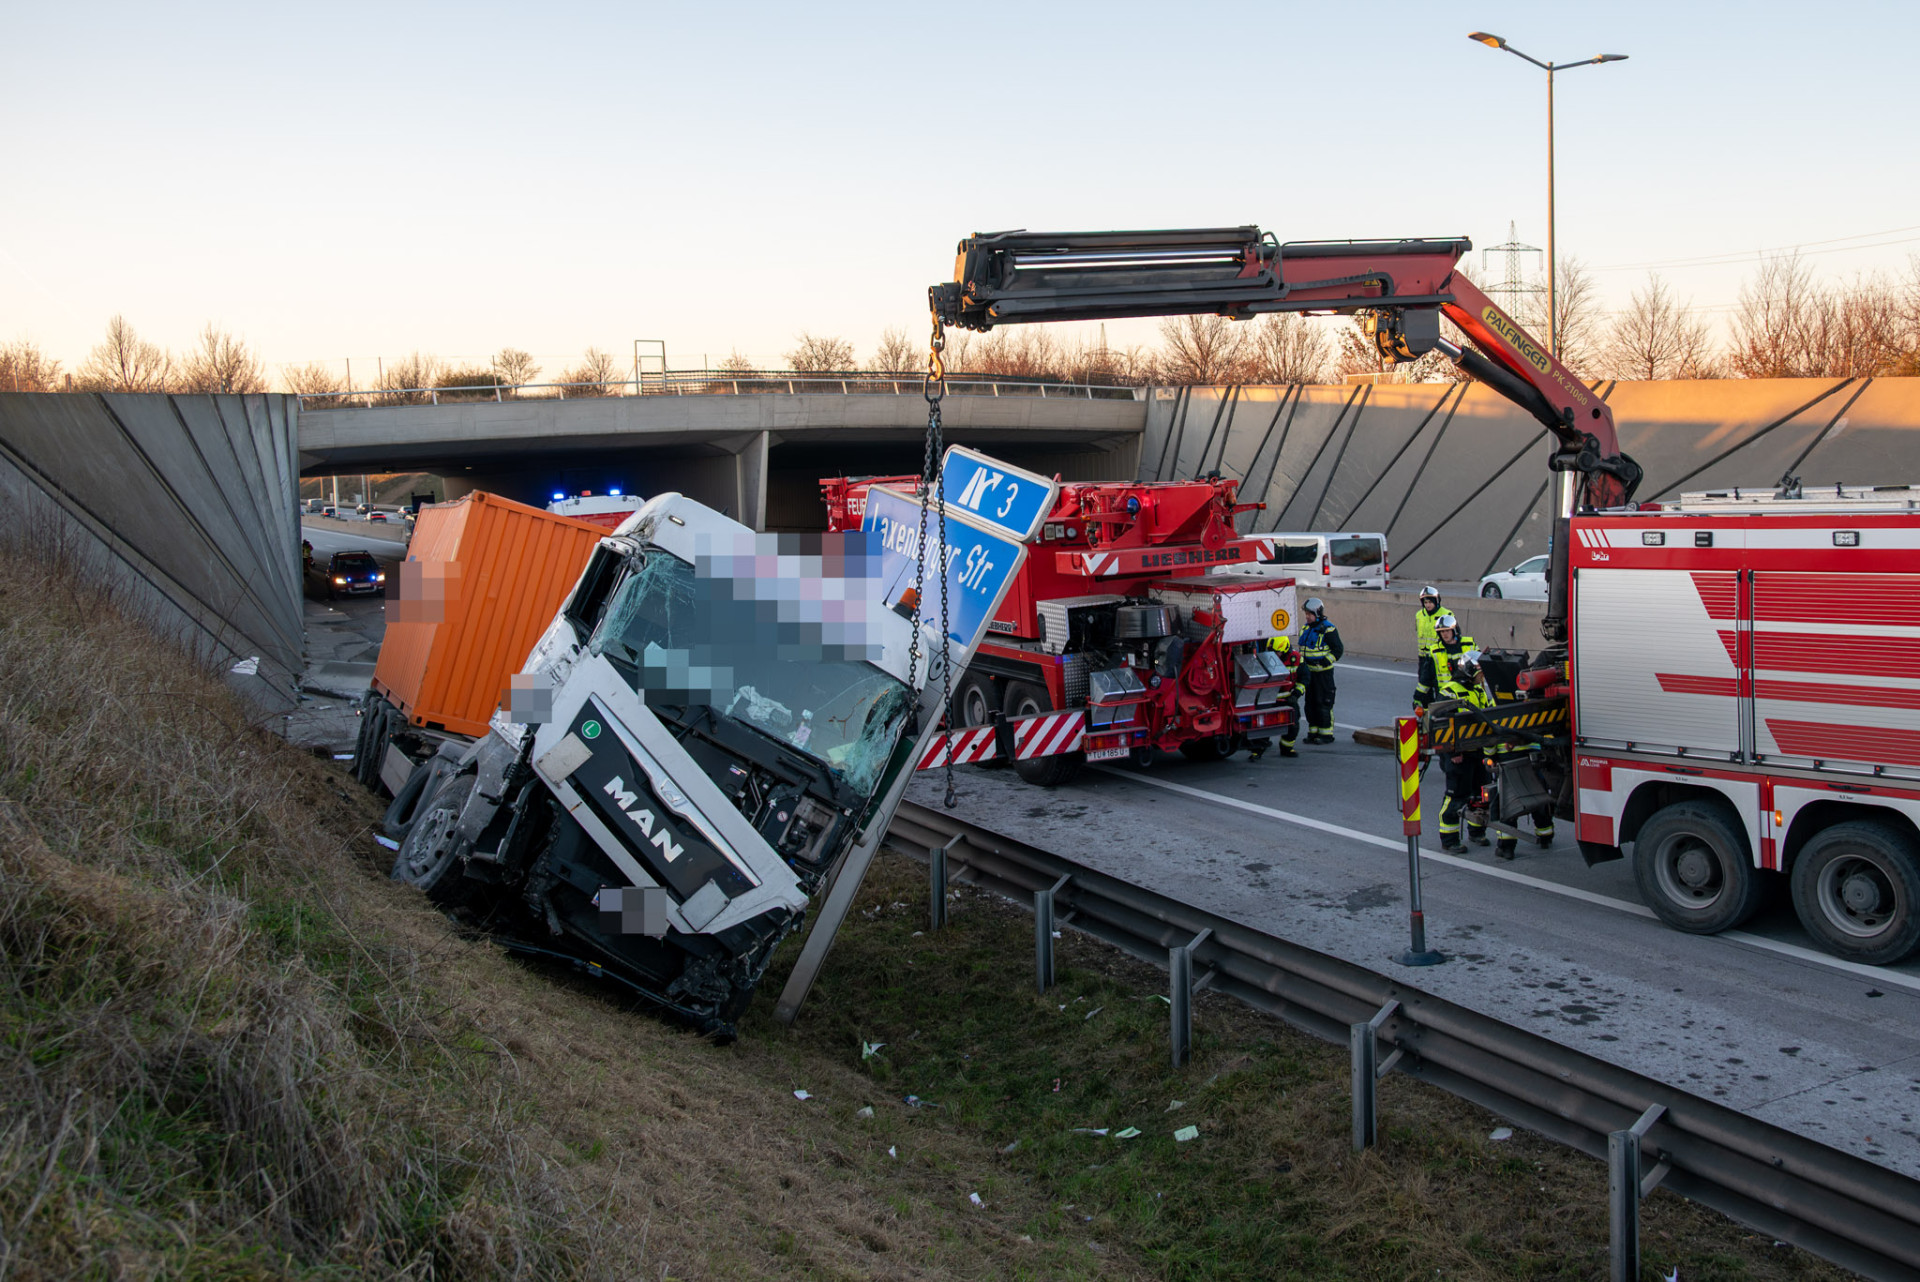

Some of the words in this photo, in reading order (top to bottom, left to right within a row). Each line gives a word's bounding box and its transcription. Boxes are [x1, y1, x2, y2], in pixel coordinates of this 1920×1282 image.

[1485, 309, 1548, 371] PALFINGER
[1552, 370, 1565, 385] PK
[1564, 384, 1588, 406] 21000
[997, 483, 1018, 518] 3
[958, 544, 994, 595] Str.
[1142, 547, 1241, 568] LIEBHERR
[1276, 614, 1286, 626] R
[584, 723, 596, 736] L
[603, 775, 684, 863] MAN
